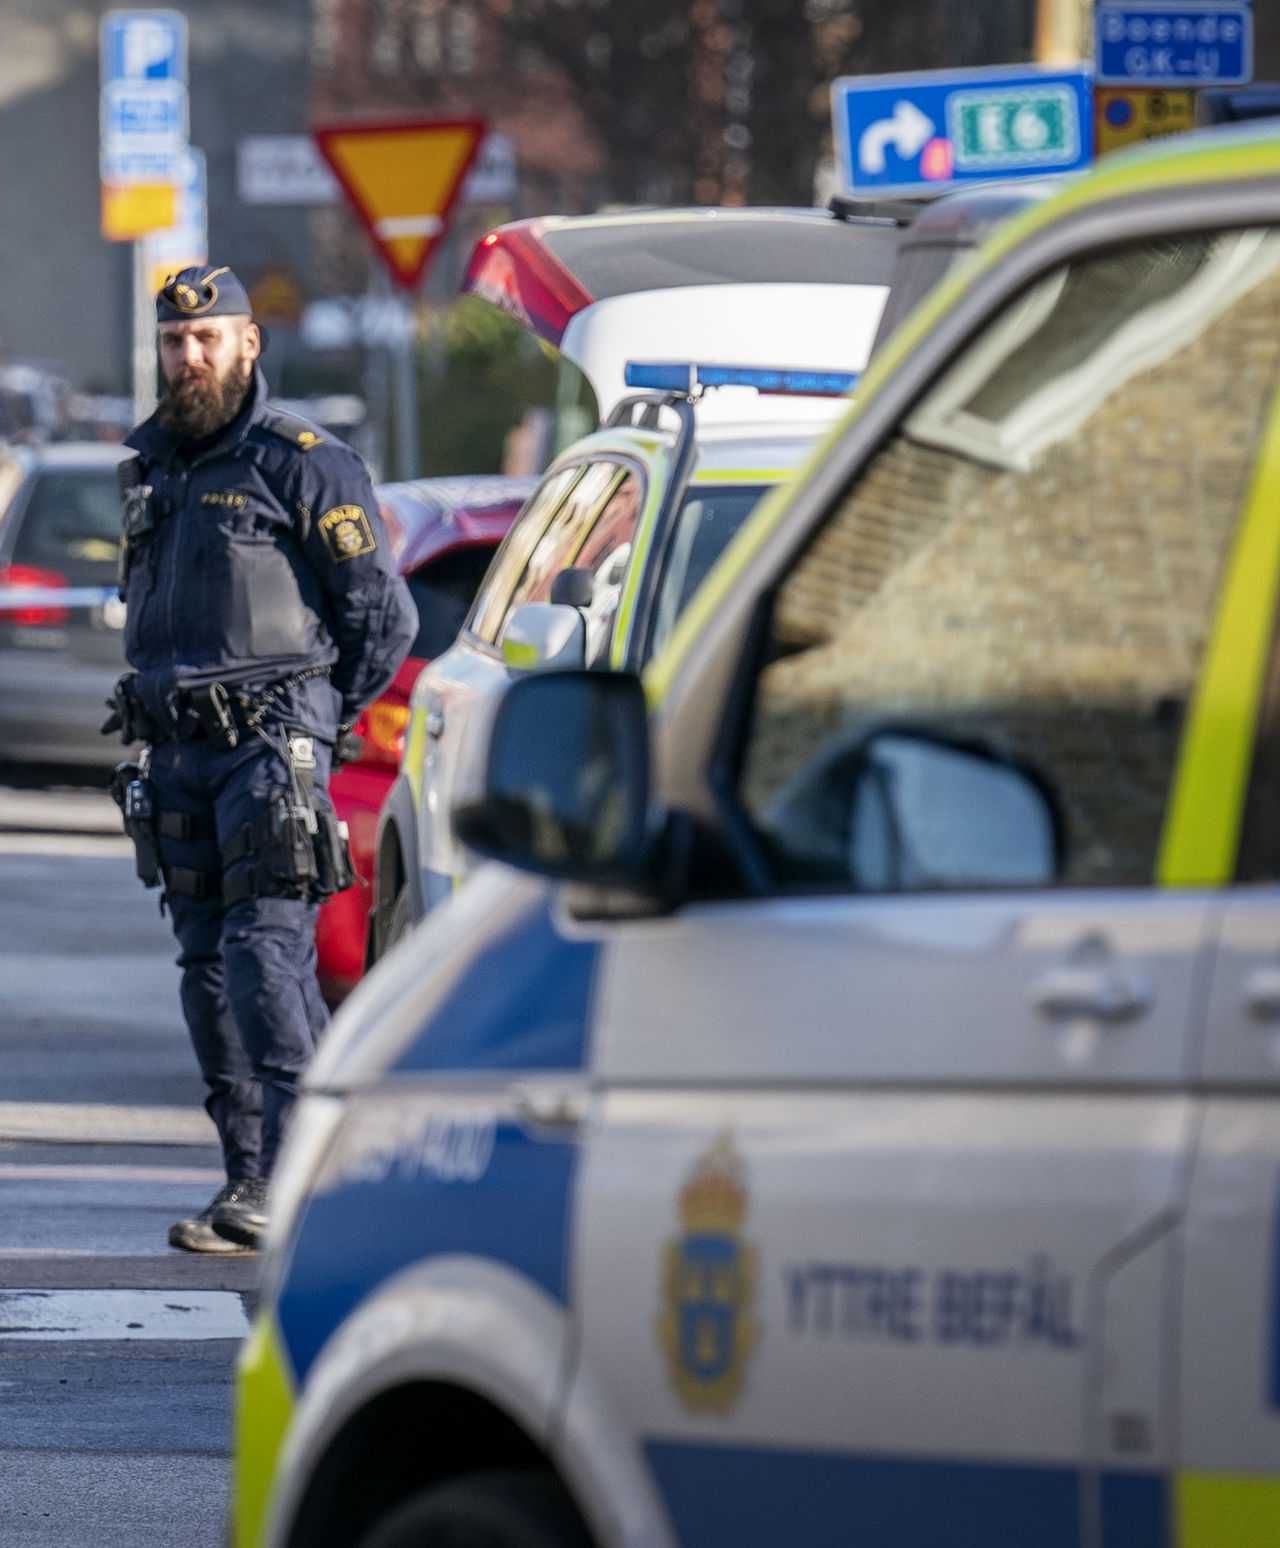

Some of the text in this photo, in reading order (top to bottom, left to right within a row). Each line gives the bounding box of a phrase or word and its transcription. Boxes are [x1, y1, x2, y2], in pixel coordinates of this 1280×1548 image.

[976, 103, 1048, 153] E6
[323, 508, 360, 529] POLIS
[785, 1264, 921, 1343] YTTRE
